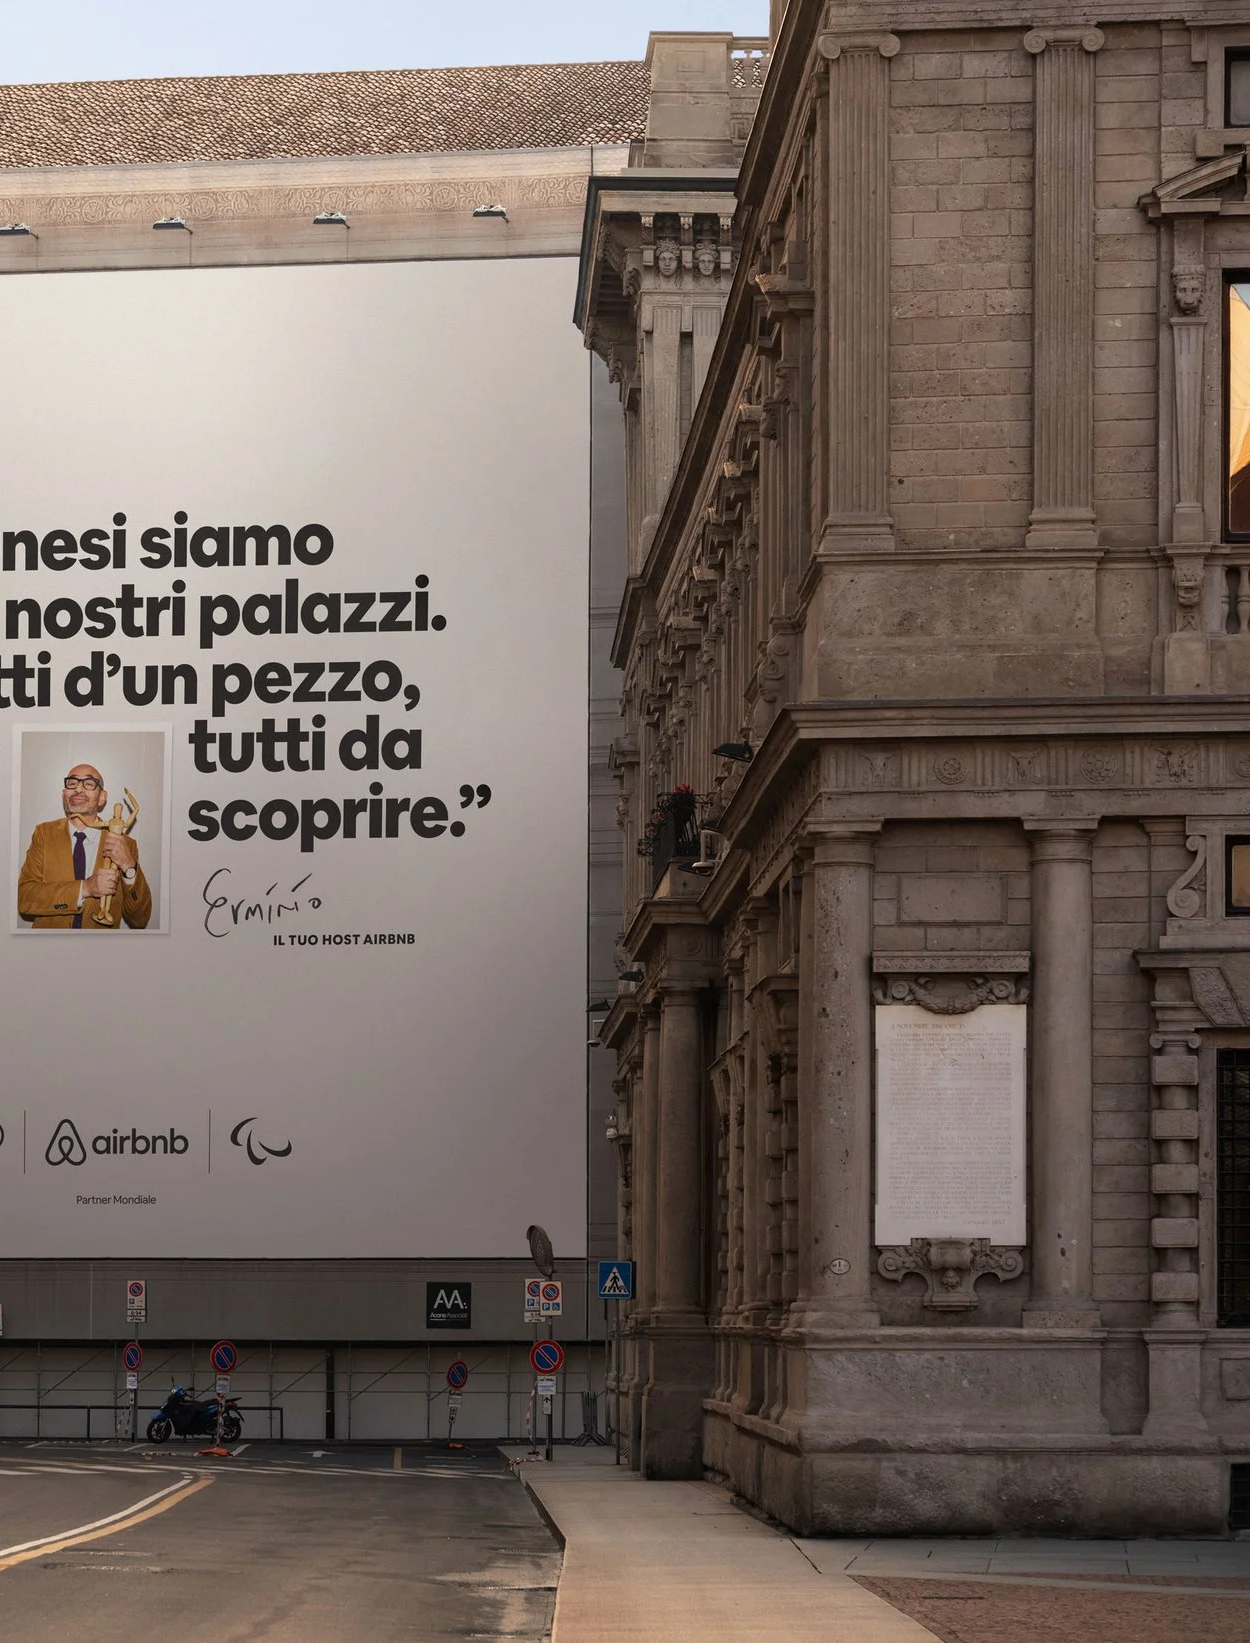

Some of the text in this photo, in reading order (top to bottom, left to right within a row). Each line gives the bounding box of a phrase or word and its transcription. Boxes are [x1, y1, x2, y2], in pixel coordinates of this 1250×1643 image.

[139, 510, 335, 569] siamo
[5, 578, 187, 640] nostri
[199, 573, 448, 650] palazzi.
[211, 658, 422, 718] pezzo,
[187, 713, 423, 774] tutti da
[273, 933, 416, 946] IL TUO HOST AIRBNB
[92, 1127, 190, 1156] airbnb
[76, 1194, 157, 1205] Partner Mondiale
